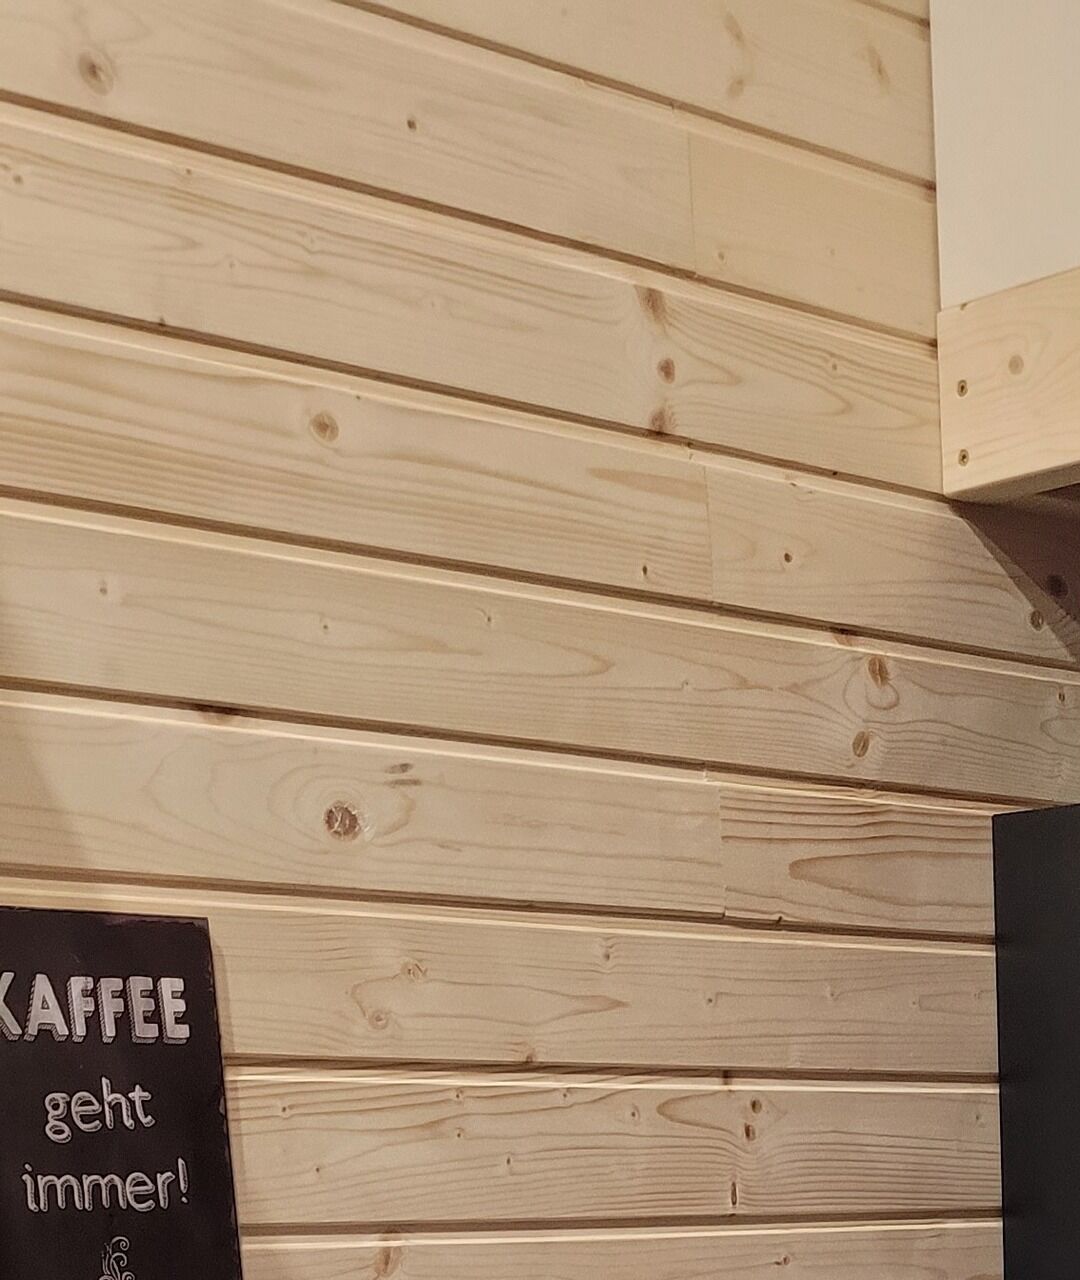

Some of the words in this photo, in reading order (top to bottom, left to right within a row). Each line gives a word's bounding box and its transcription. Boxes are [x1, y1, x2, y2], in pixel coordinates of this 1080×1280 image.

[0, 971, 191, 1043] KAFFEE
[45, 1075, 156, 1143] geht
[22, 1156, 190, 1213] immer!
